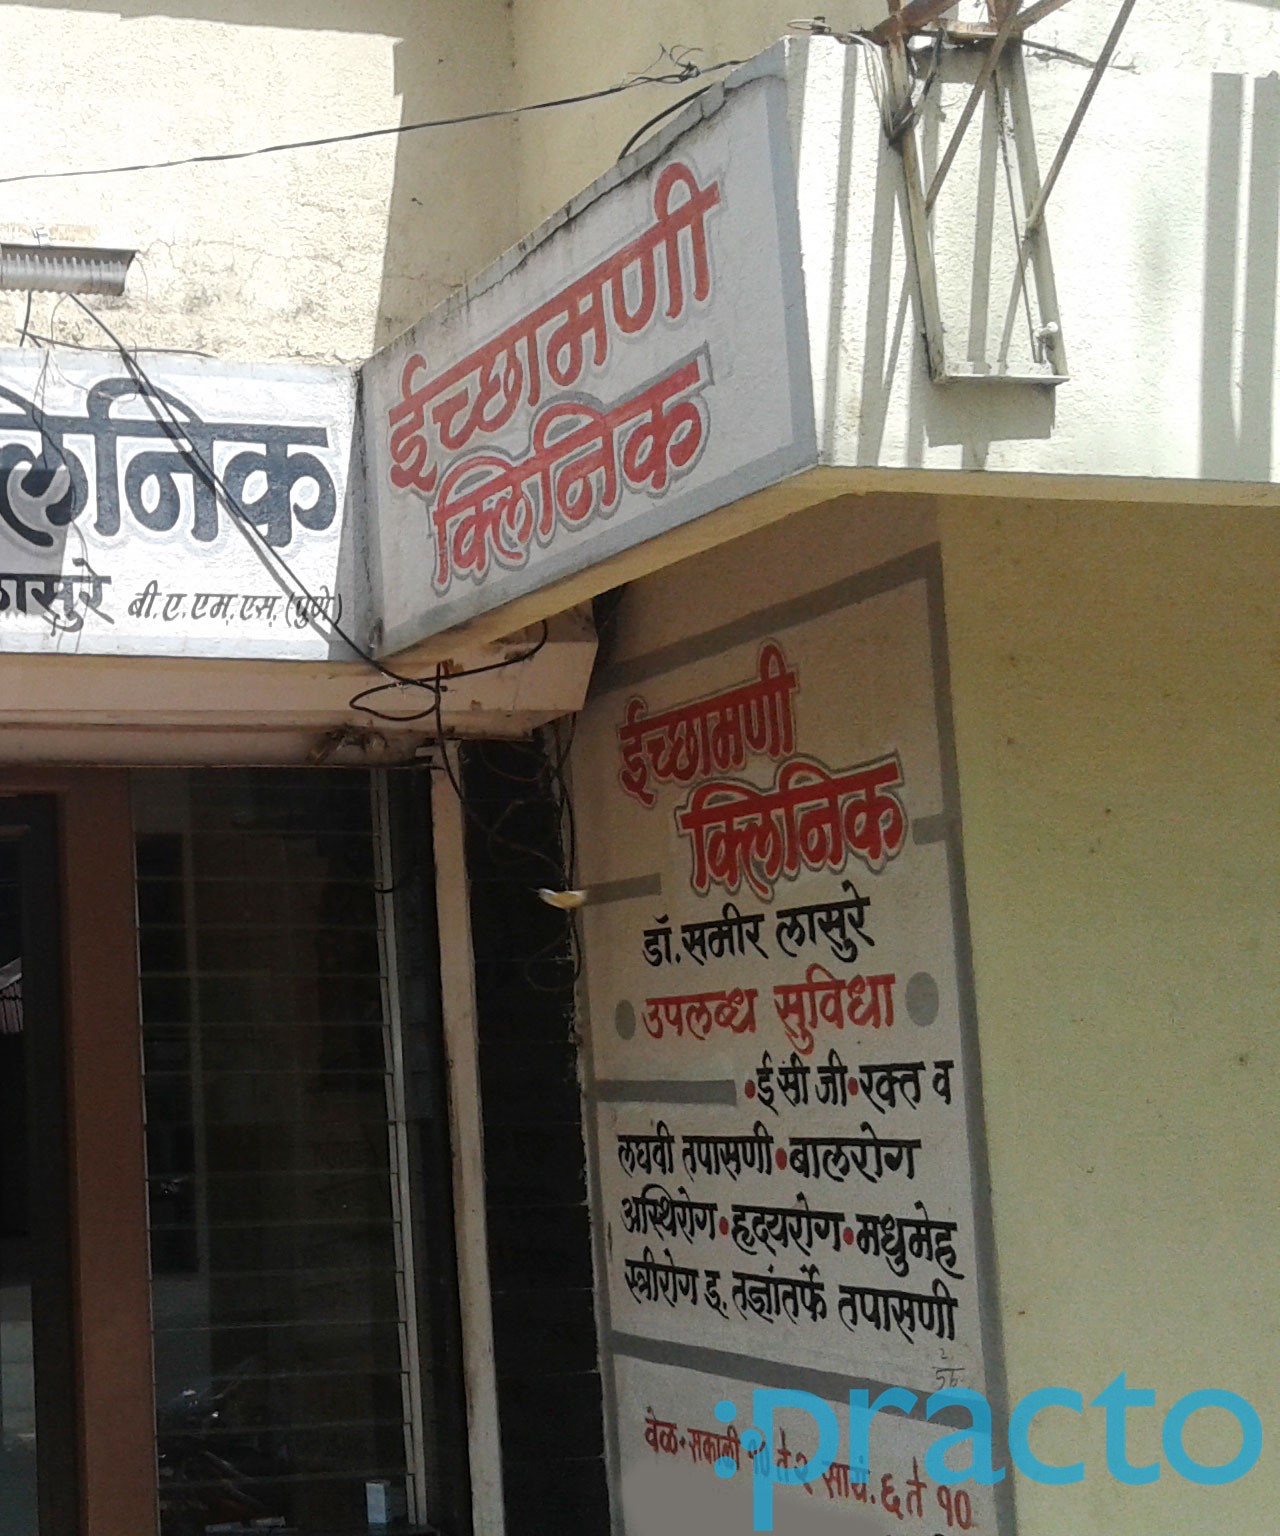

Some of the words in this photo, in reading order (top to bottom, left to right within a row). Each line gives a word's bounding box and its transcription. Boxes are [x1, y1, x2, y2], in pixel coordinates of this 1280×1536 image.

[389, 162, 720, 492] ईच्छामणी
[433, 358, 702, 585] क्लिनिक
[619, 644, 797, 804] ईच्छामणी
[681, 759, 905, 894] क्लिनिक
[680, 903, 769, 966] समीर
[776, 880, 875, 963] लासुरे
[642, 987, 758, 1040] उपलब्ध
[773, 963, 896, 1055] सुविधा
[858, 1061, 926, 1114] रक्त
[932, 1060, 955, 1105] व
[617, 1121, 675, 1177] लघवी
[682, 1120, 774, 1182] तपासणी
[789, 1121, 922, 1183] बालरोग
[621, 1184, 718, 1244] अस्थिरोग
[856, 1200, 965, 1280] मधुमेह
[625, 1246, 699, 1308] स्त्रीरोग
[838, 1278, 959, 1344] तपासणी
